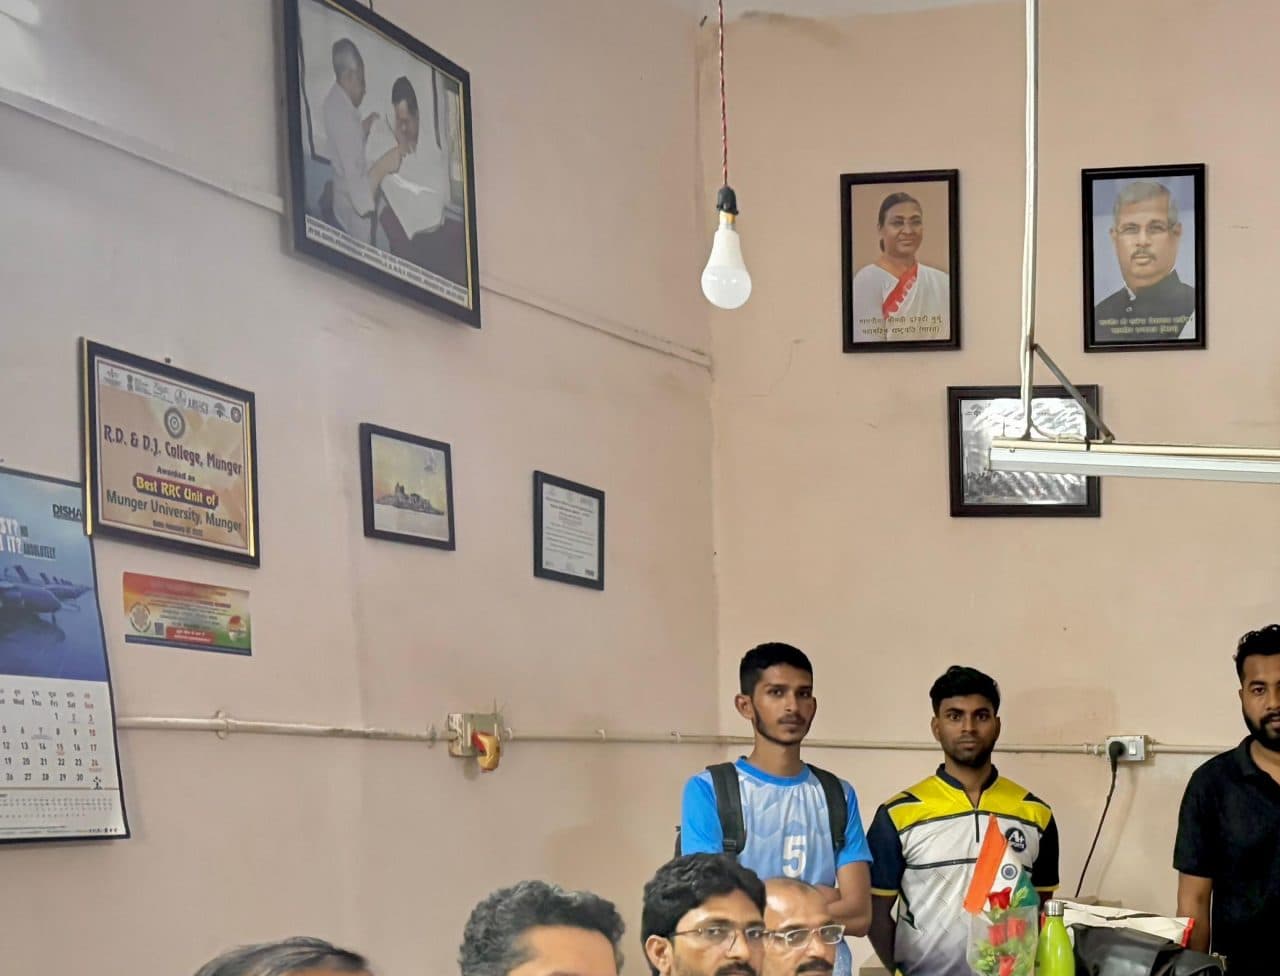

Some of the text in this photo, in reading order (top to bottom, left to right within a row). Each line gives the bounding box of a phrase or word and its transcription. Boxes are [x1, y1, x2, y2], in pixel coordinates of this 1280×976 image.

[103, 424, 127, 447] R.D.
[130, 432, 139, 448] &
[165, 441, 204, 467] College,
[206, 452, 242, 477] Munger
[157, 466, 187, 480] Awarded
[136, 476, 217, 507] Best RRC Unit of
[106, 489, 148, 512] Munger
[150, 500, 203, 526] University,
[205, 511, 242, 534] Munger
[3, 741, 97, 752] 12 13 14 15 16 17
[5, 757, 12, 765] 19
[23, 757, 31, 766] 20
[40, 757, 48, 766] 21
[58, 758, 65, 766] 22
[75, 758, 83, 766] 23
[60, 773, 67, 781] 29
[76, 773, 84, 781] 30
[783, 835, 806, 878] 5
